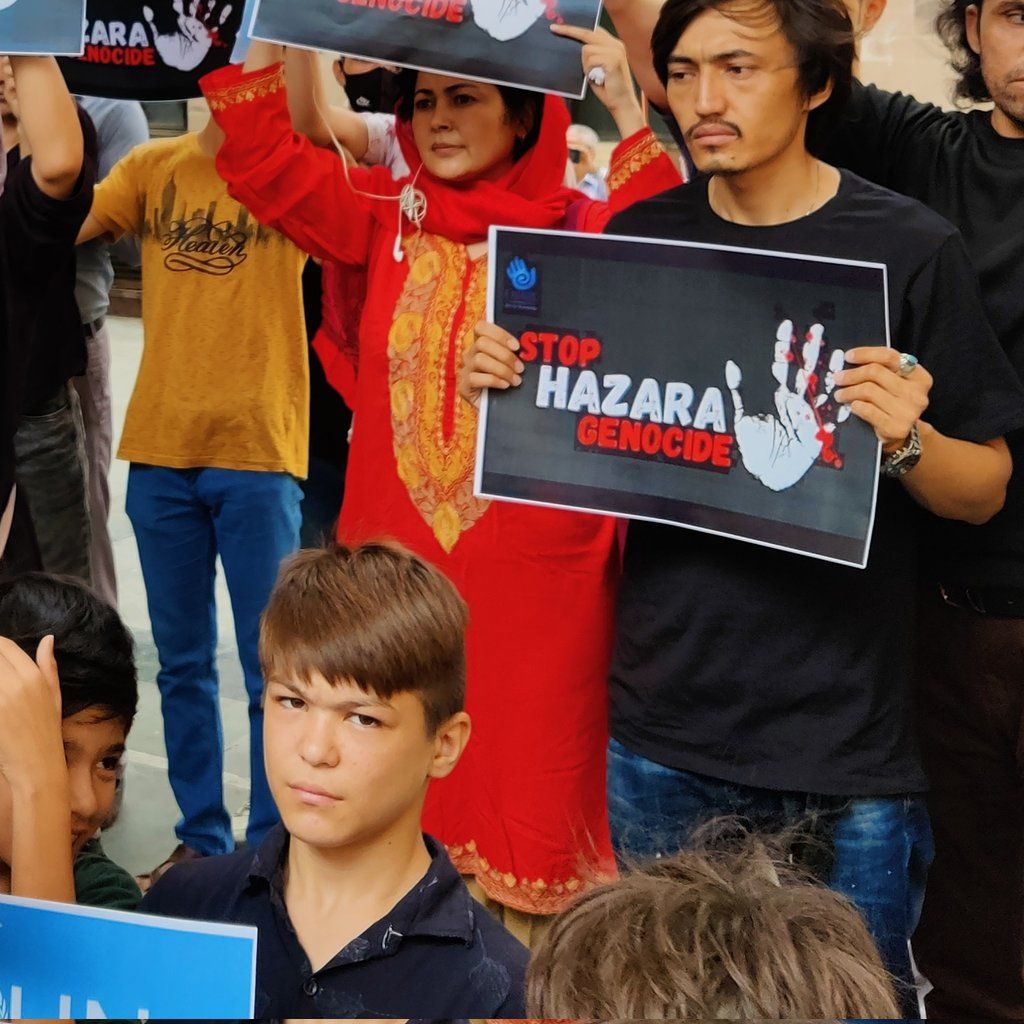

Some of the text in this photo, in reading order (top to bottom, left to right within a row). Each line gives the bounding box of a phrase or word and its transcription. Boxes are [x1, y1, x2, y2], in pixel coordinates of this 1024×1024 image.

[519, 331, 602, 367] STOP
[536, 364, 727, 433] HAZARA
[577, 415, 734, 468] GENOCIDE
